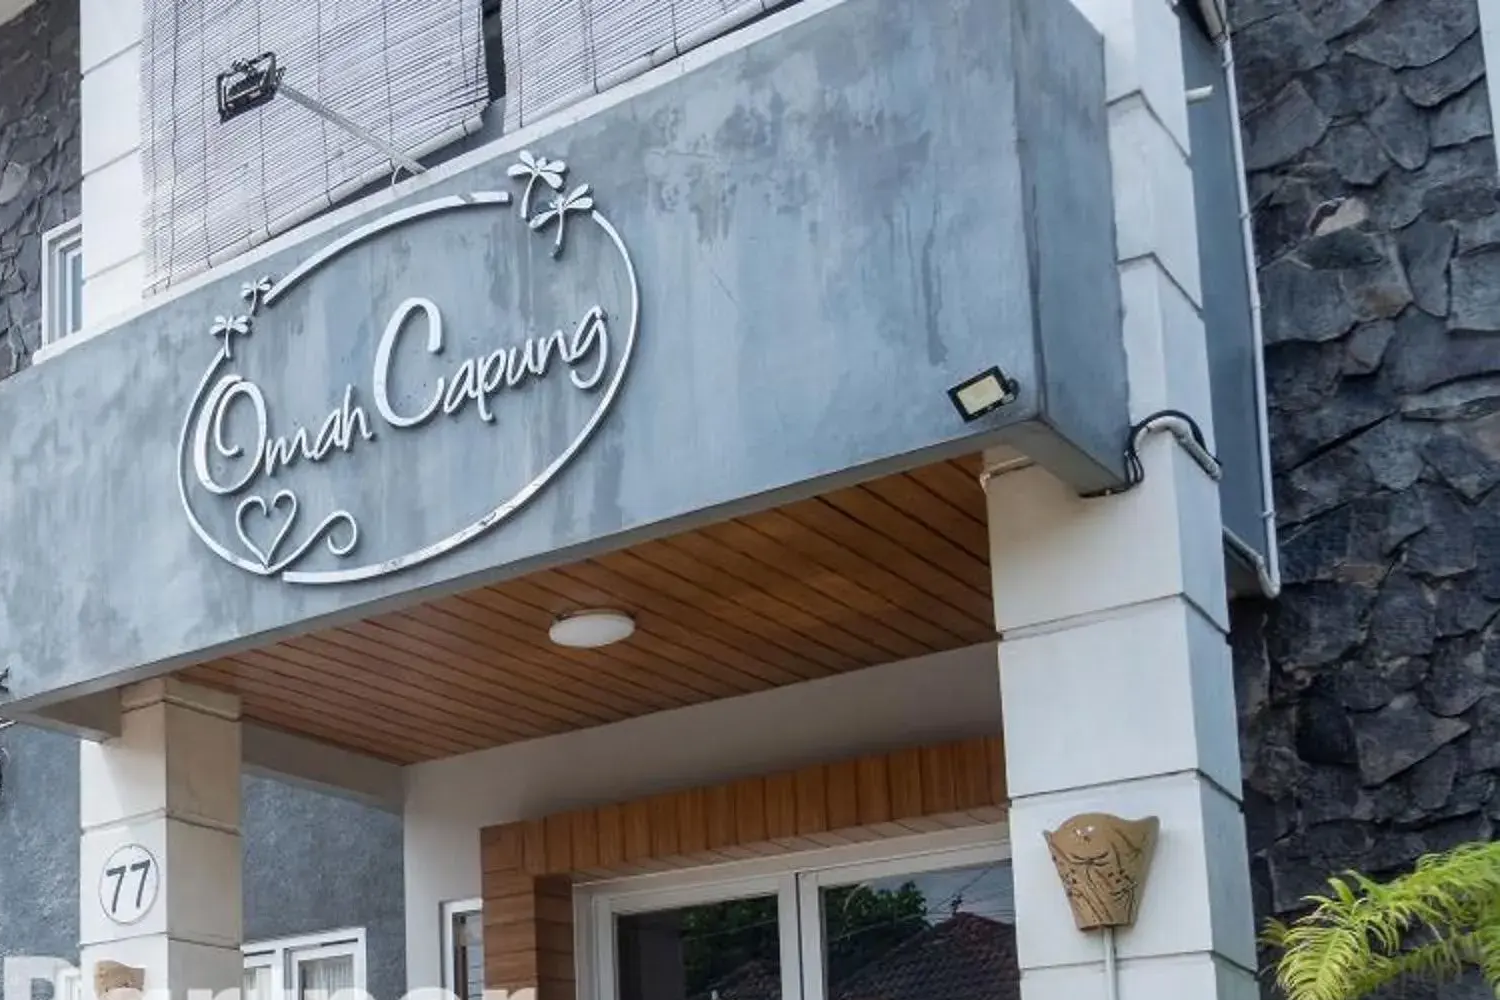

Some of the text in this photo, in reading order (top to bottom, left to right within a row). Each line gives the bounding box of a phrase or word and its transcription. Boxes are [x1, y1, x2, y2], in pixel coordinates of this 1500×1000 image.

[193, 297, 609, 494] Omah Capung
[105, 858, 151, 914] 77
